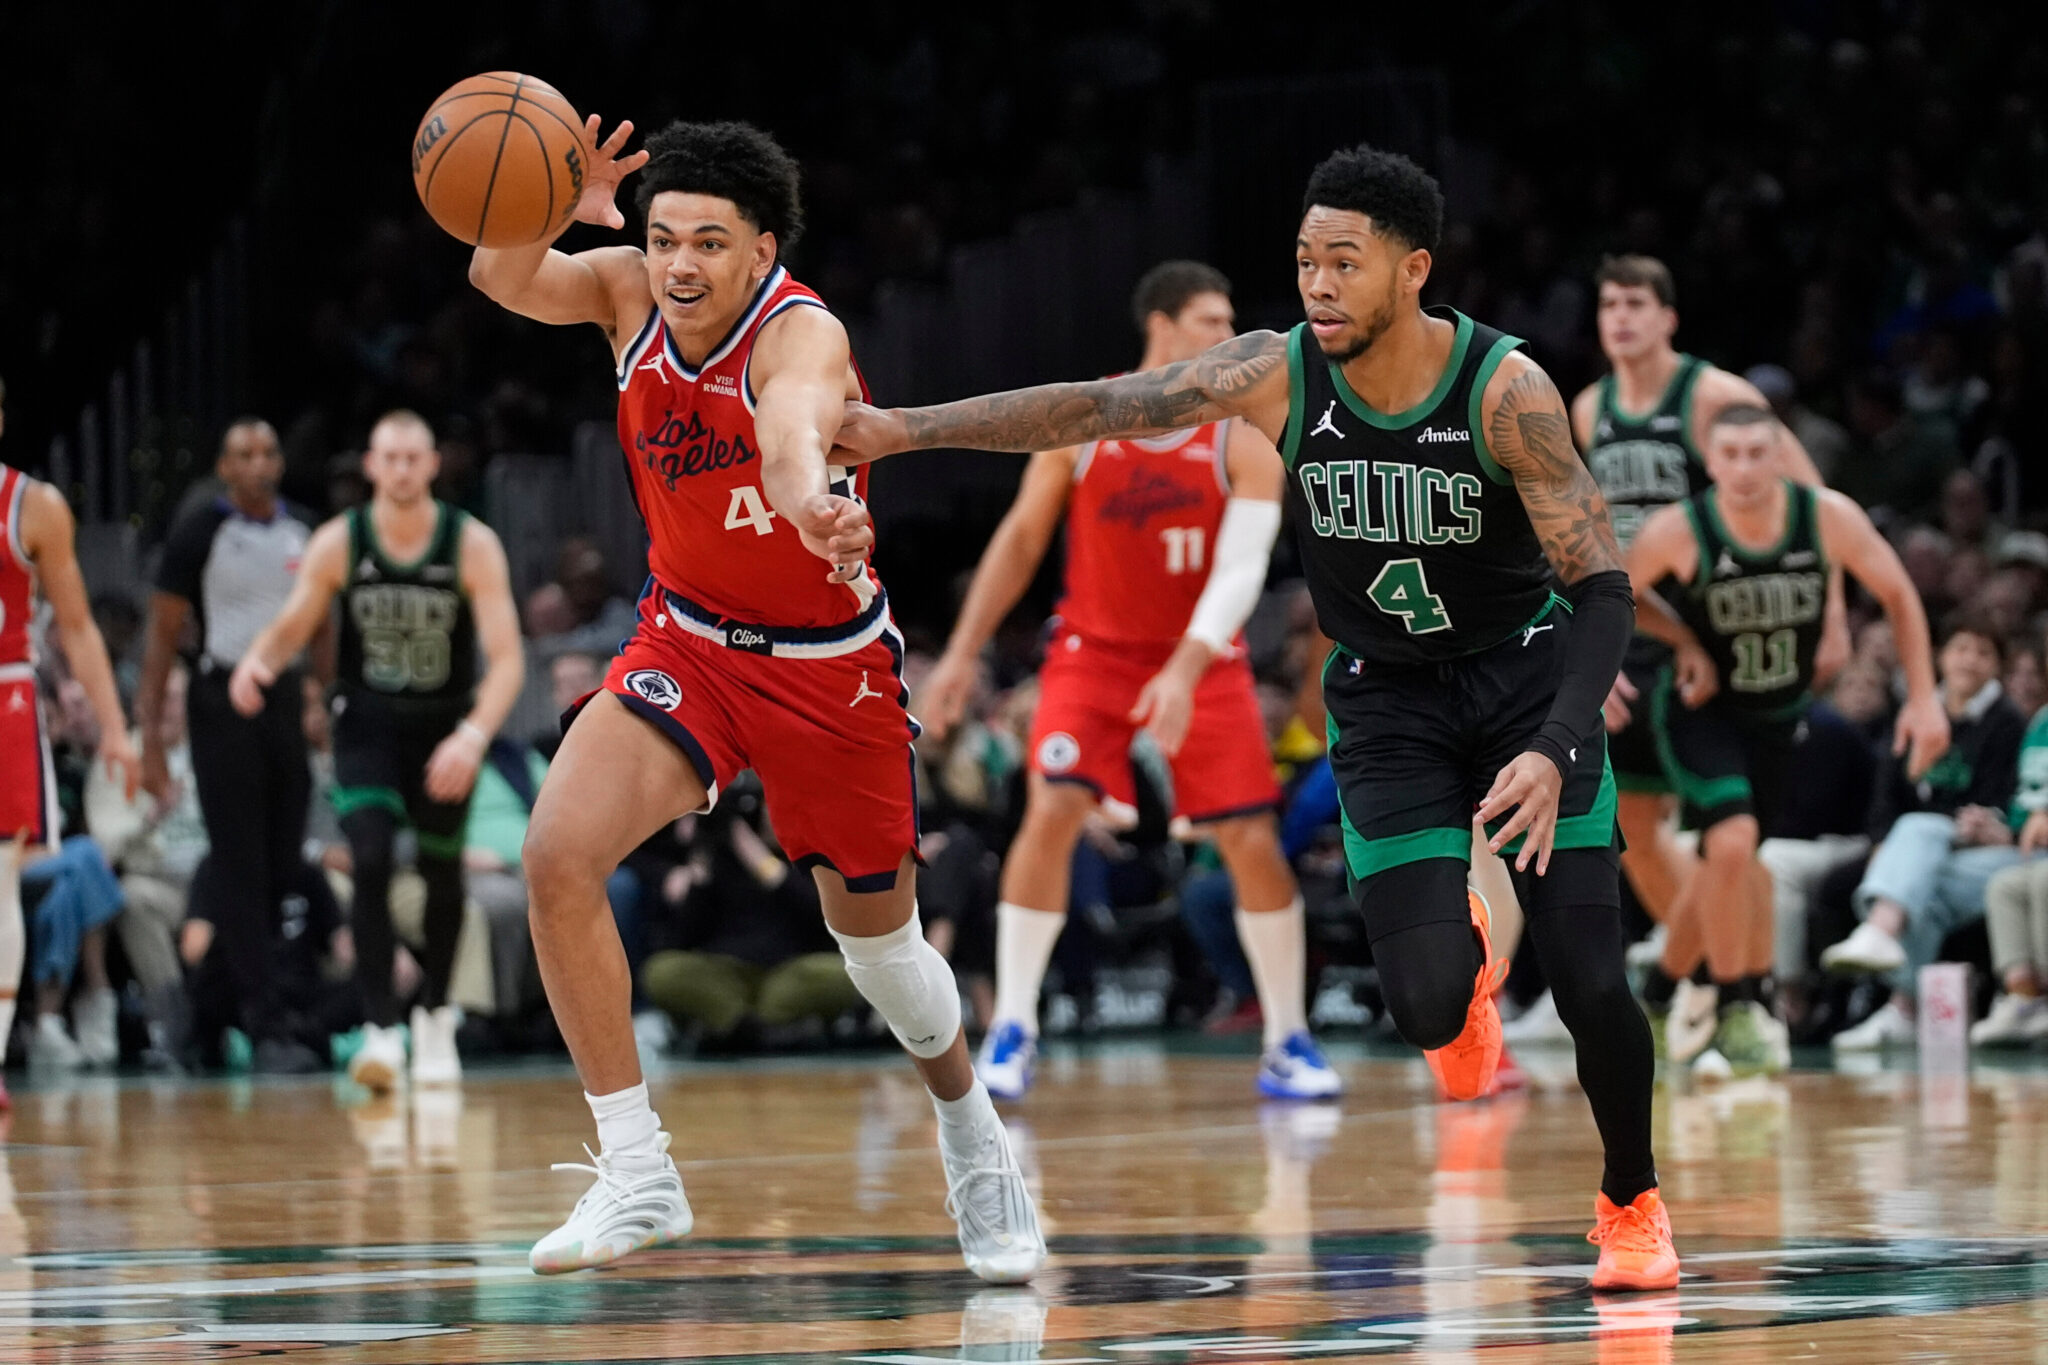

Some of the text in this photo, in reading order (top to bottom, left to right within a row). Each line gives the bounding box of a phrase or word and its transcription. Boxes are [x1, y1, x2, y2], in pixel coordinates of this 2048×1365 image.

[703, 382, 738, 397] RWANDA
[715, 374, 734, 386] VISIT
[648, 410, 707, 448] Los
[1417, 426, 1470, 443] Amica
[724, 486, 776, 536] 4
[1299, 460, 1482, 545] CELTICS
[1160, 526, 1205, 575] 11
[1366, 557, 1453, 635] 4
[731, 629, 766, 646] Clips
[1731, 628, 1799, 693] 11
